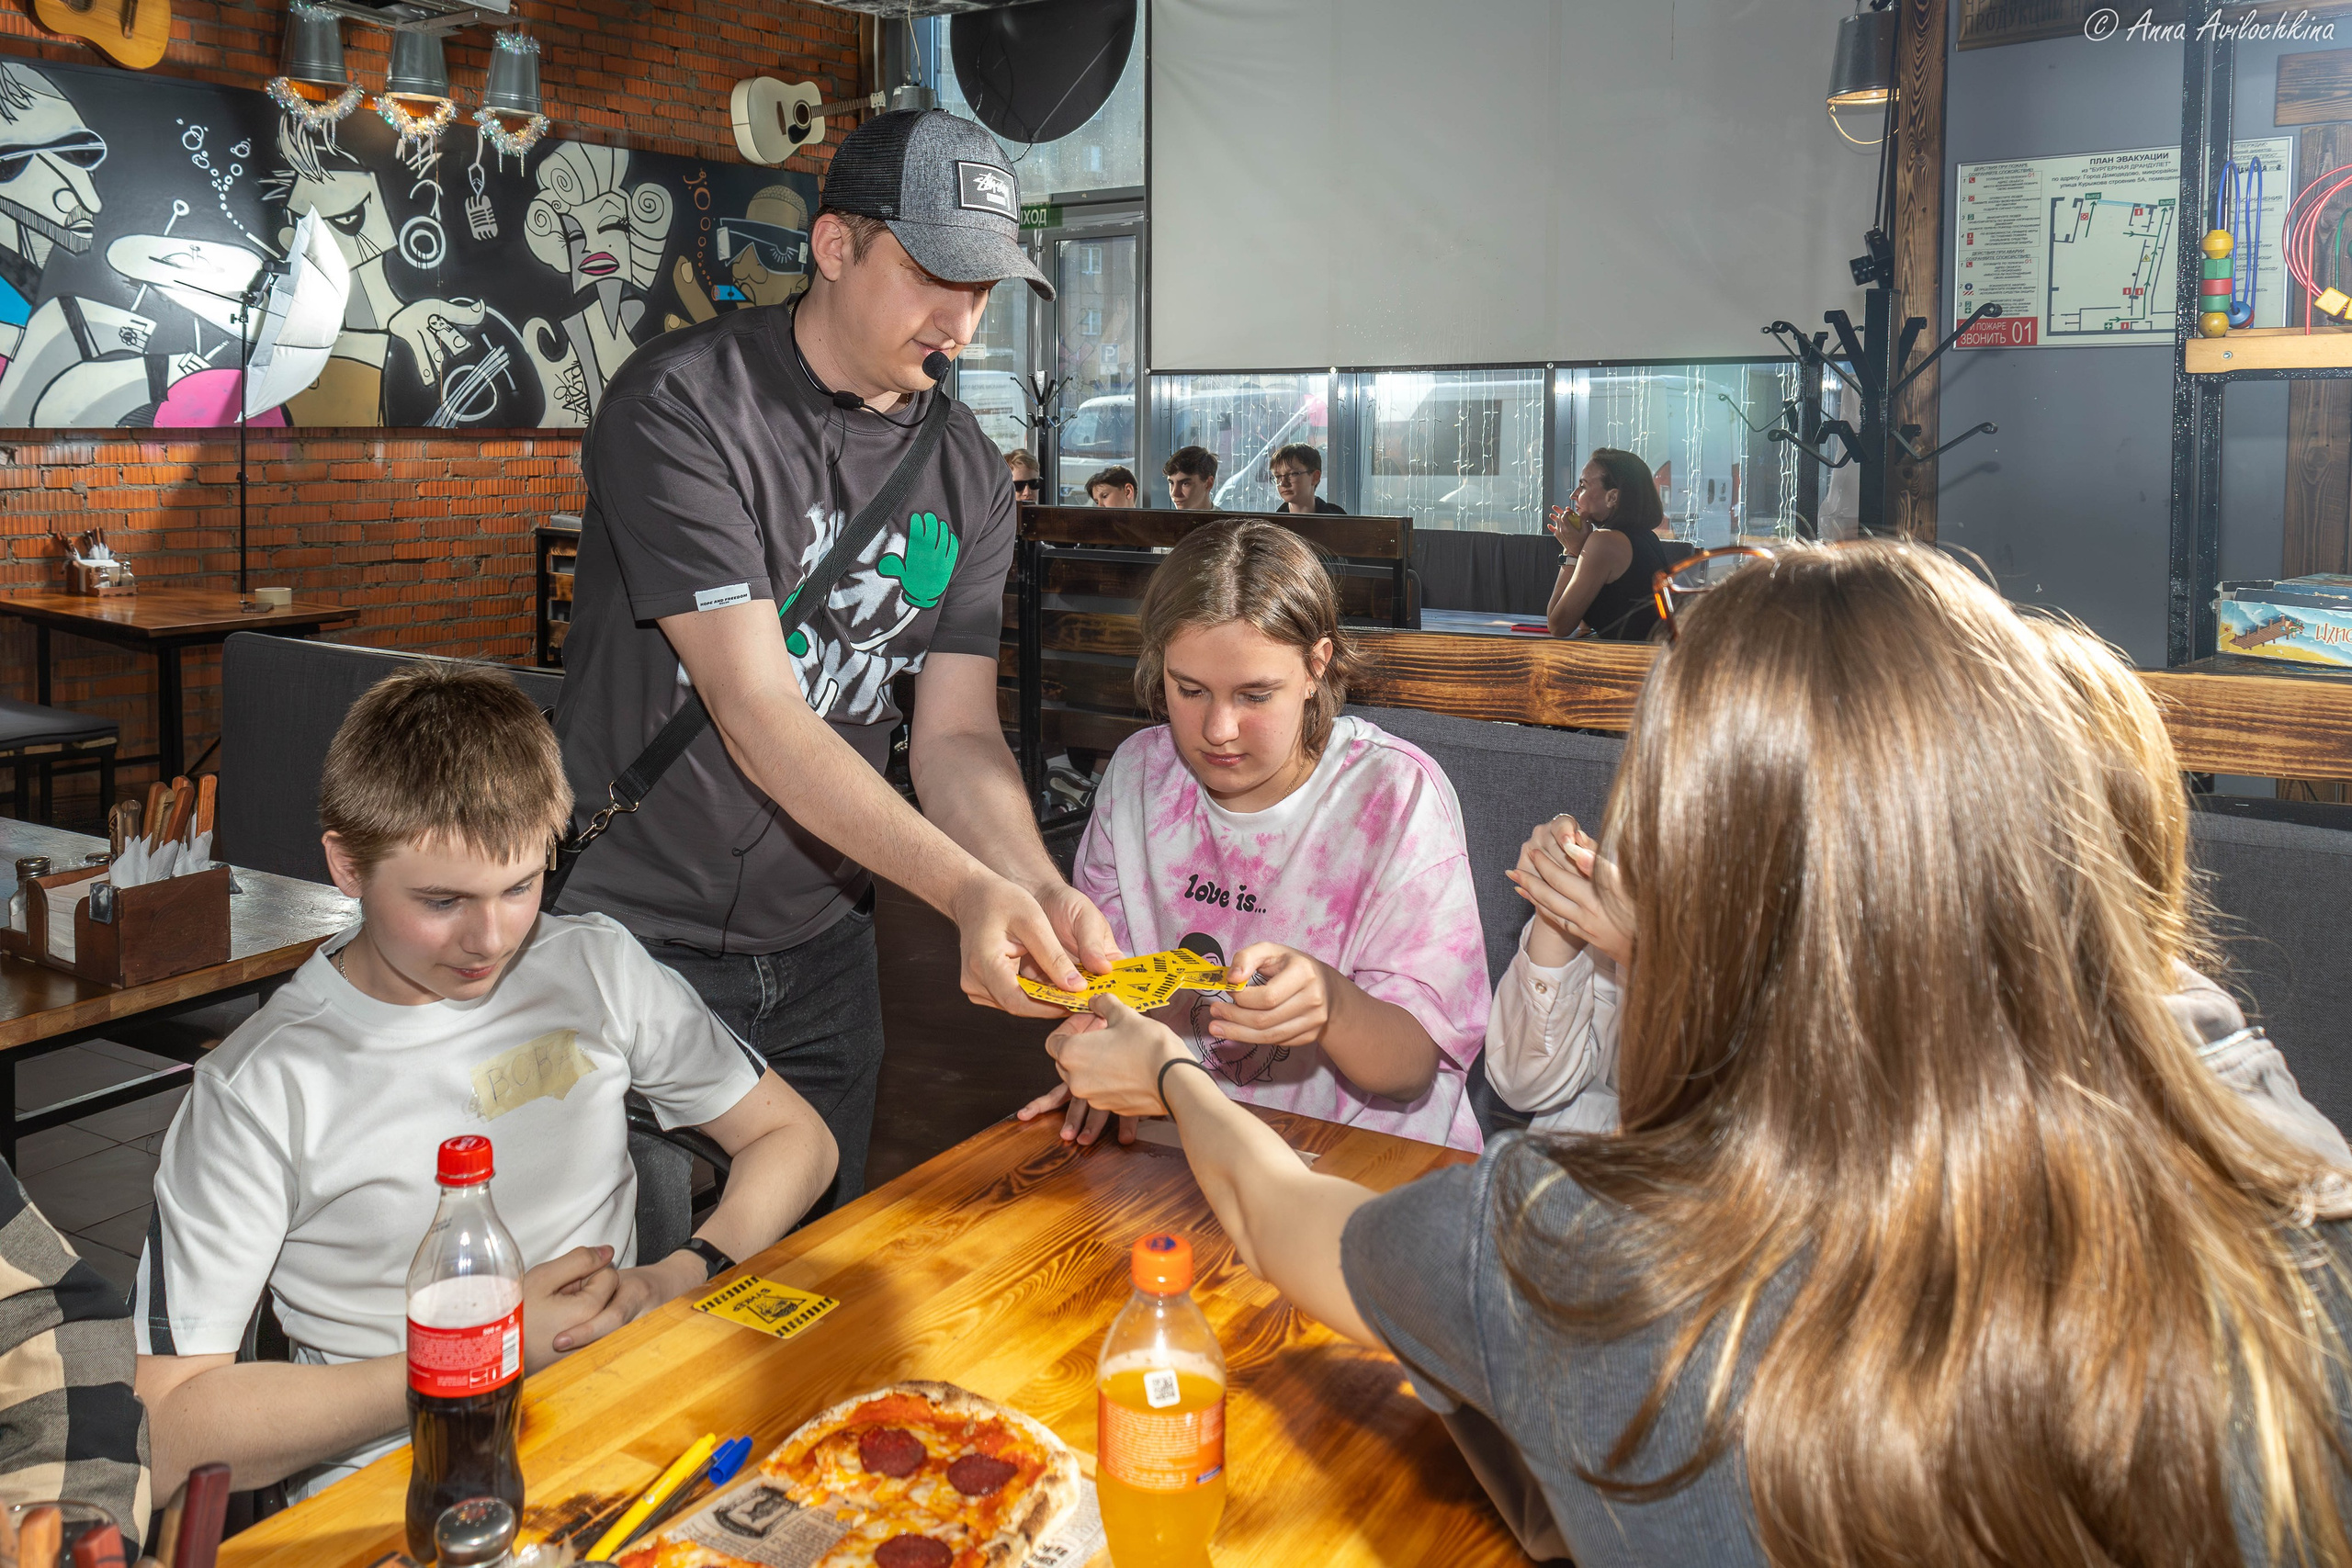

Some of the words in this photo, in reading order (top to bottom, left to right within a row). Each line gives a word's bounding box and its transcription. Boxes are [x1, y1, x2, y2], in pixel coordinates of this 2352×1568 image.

[2116, 152, 2169, 163] ЭВАКУАЦИИ
[2148, 174, 2180, 183] помещени
[1020, 208, 1047, 227] ХОД
[1976, 321, 2007, 331] ПОЖАРЕ
[2012, 321, 2031, 344] 01
[1961, 333, 2007, 344] ЗВОНИТЬ
[724, 593, 748, 602] FREEDOM
[1184, 874, 1230, 908] love
[1236, 885, 1267, 914] is...
